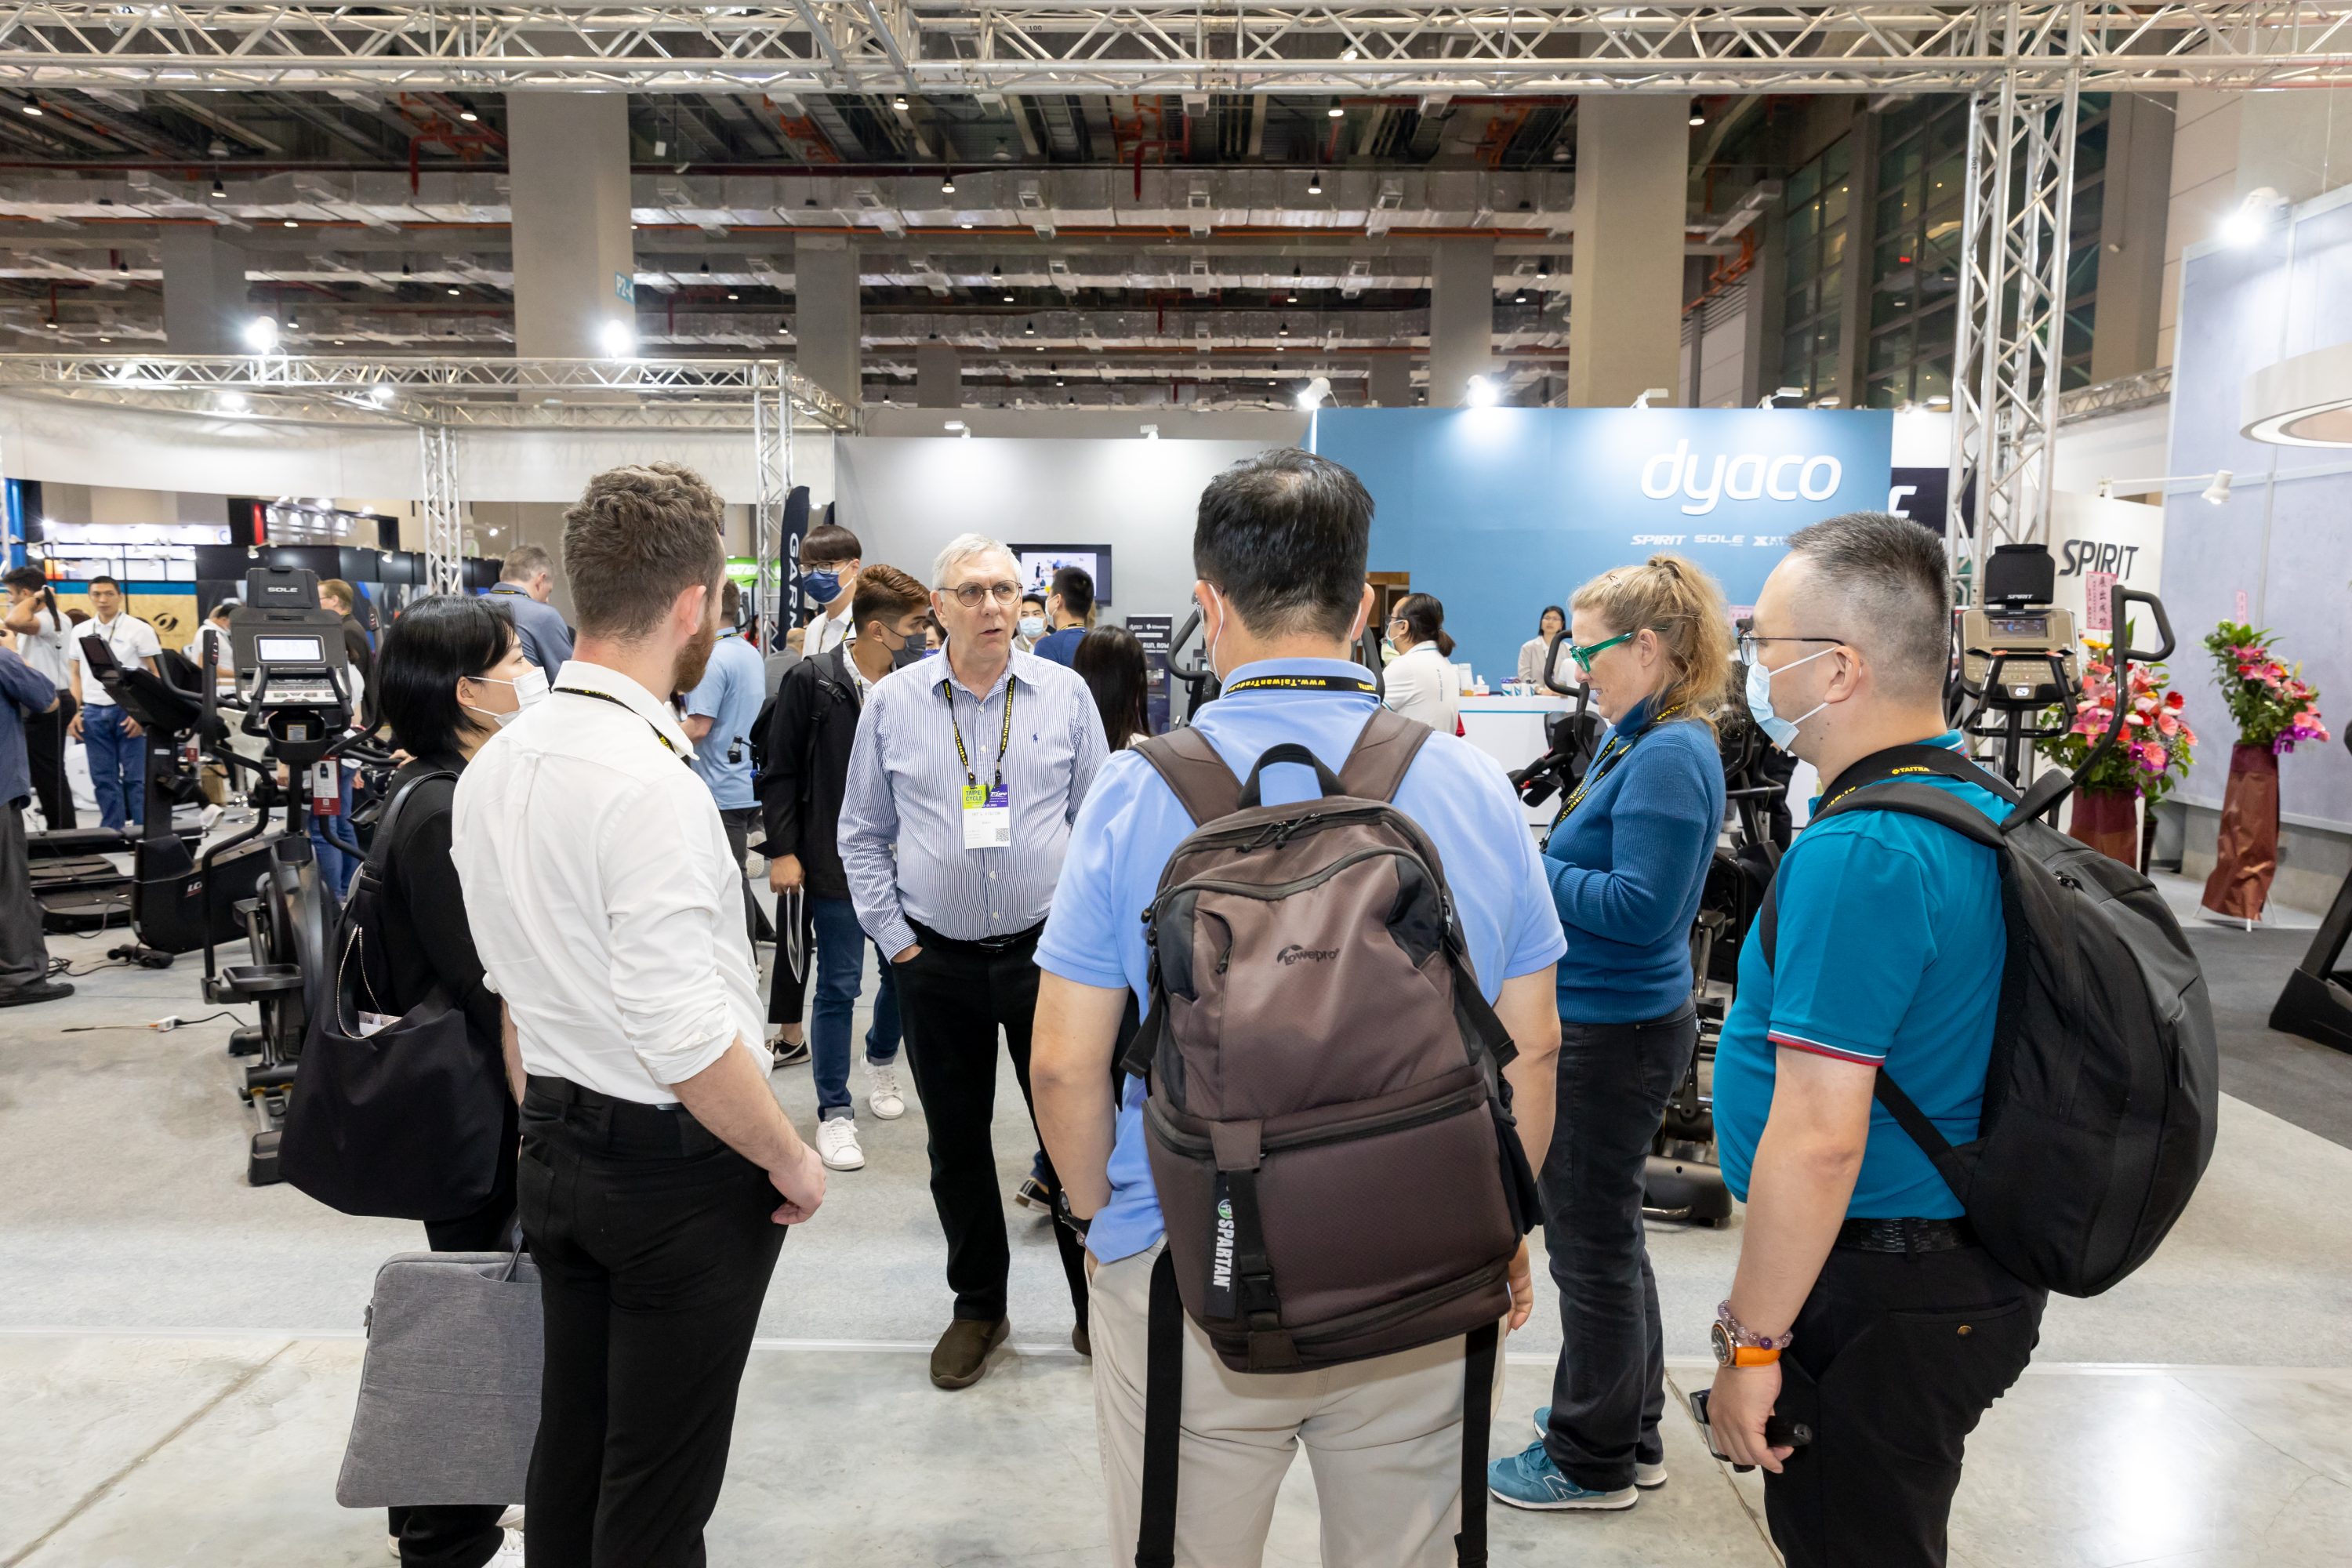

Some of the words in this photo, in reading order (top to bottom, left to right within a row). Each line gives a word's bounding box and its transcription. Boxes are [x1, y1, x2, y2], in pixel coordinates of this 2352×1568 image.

[615, 274, 634, 302] P2-4
[1641, 438, 1842, 516] dyaco
[1630, 534, 1687, 546] SPIRIT
[1693, 534, 1745, 543] SOLE
[2058, 539, 2140, 581] SPIRIT
[1283, 948, 1338, 966] Lowepro
[1213, 1218, 1235, 1287] SPARTAN
